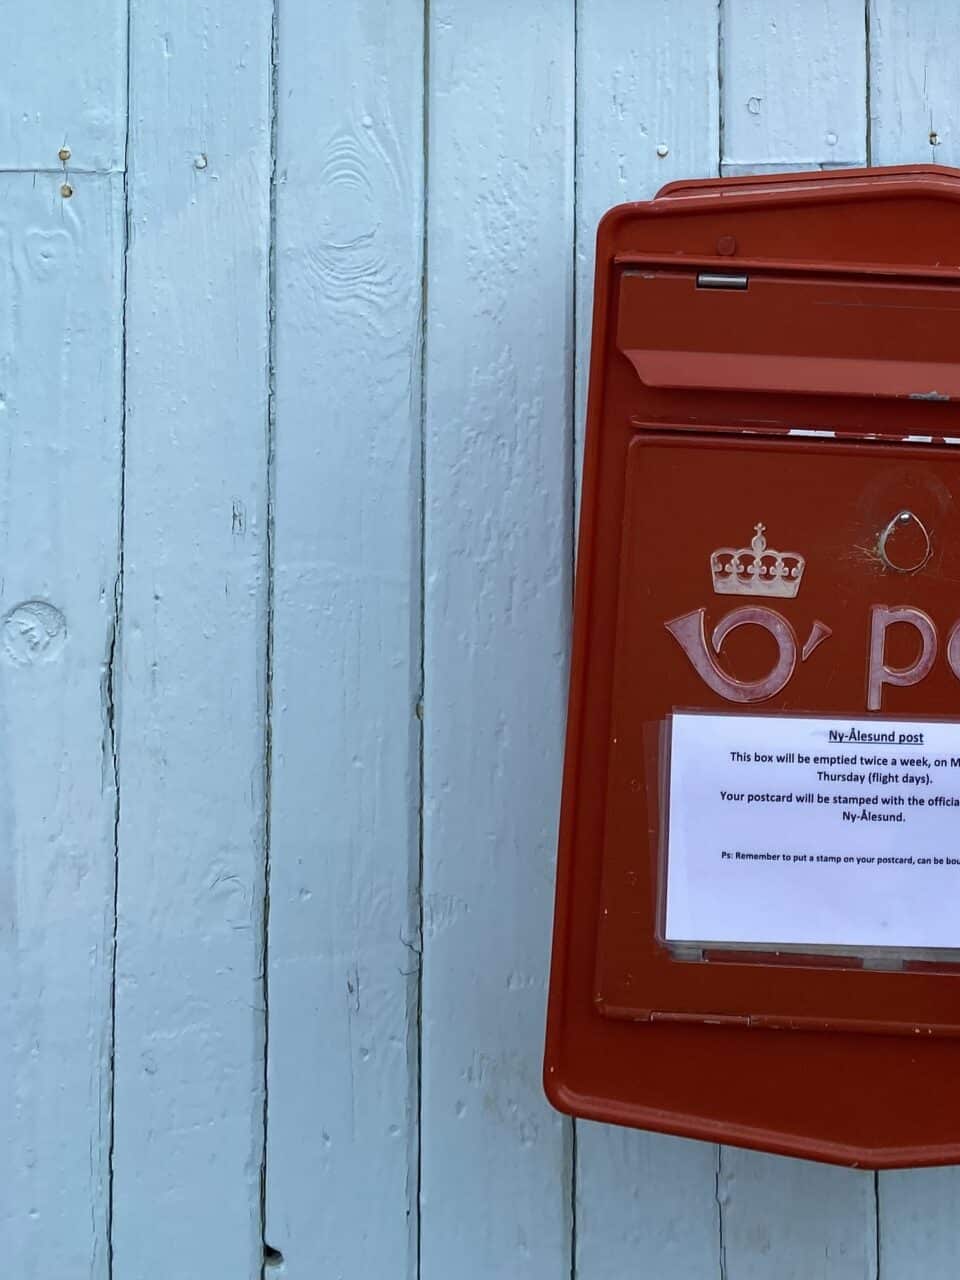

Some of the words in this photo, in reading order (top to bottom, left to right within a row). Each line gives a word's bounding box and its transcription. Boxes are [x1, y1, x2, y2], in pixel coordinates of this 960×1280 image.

[828, 728, 896, 744] Ny-Ålesund
[898, 733, 924, 745] post
[730, 752, 751, 762] This
[754, 752, 773, 763] box
[776, 752, 794, 763] will
[798, 753, 810, 764] be
[813, 755, 857, 766] emptied
[860, 756, 888, 766] twice
[891, 758, 897, 766] a
[900, 756, 931, 768] week,
[934, 759, 947, 767] on
[817, 771, 865, 784] Thursday
[868, 772, 899, 784] (flight
[902, 773, 933, 786] days).
[720, 791, 745, 801] Your
[747, 793, 793, 804] postcard
[795, 793, 814, 803] will
[817, 793, 830, 804] be
[832, 795, 878, 807] stamped
[881, 795, 904, 805] with
[908, 795, 925, 806] the
[843, 808, 906, 824] Ny-Ålesund.
[736, 852, 780, 861] Remember
[793, 854, 807, 863] put
[816, 855, 842, 864] stamp
[877, 856, 915, 865] postcard,
[933, 856, 944, 864] be
